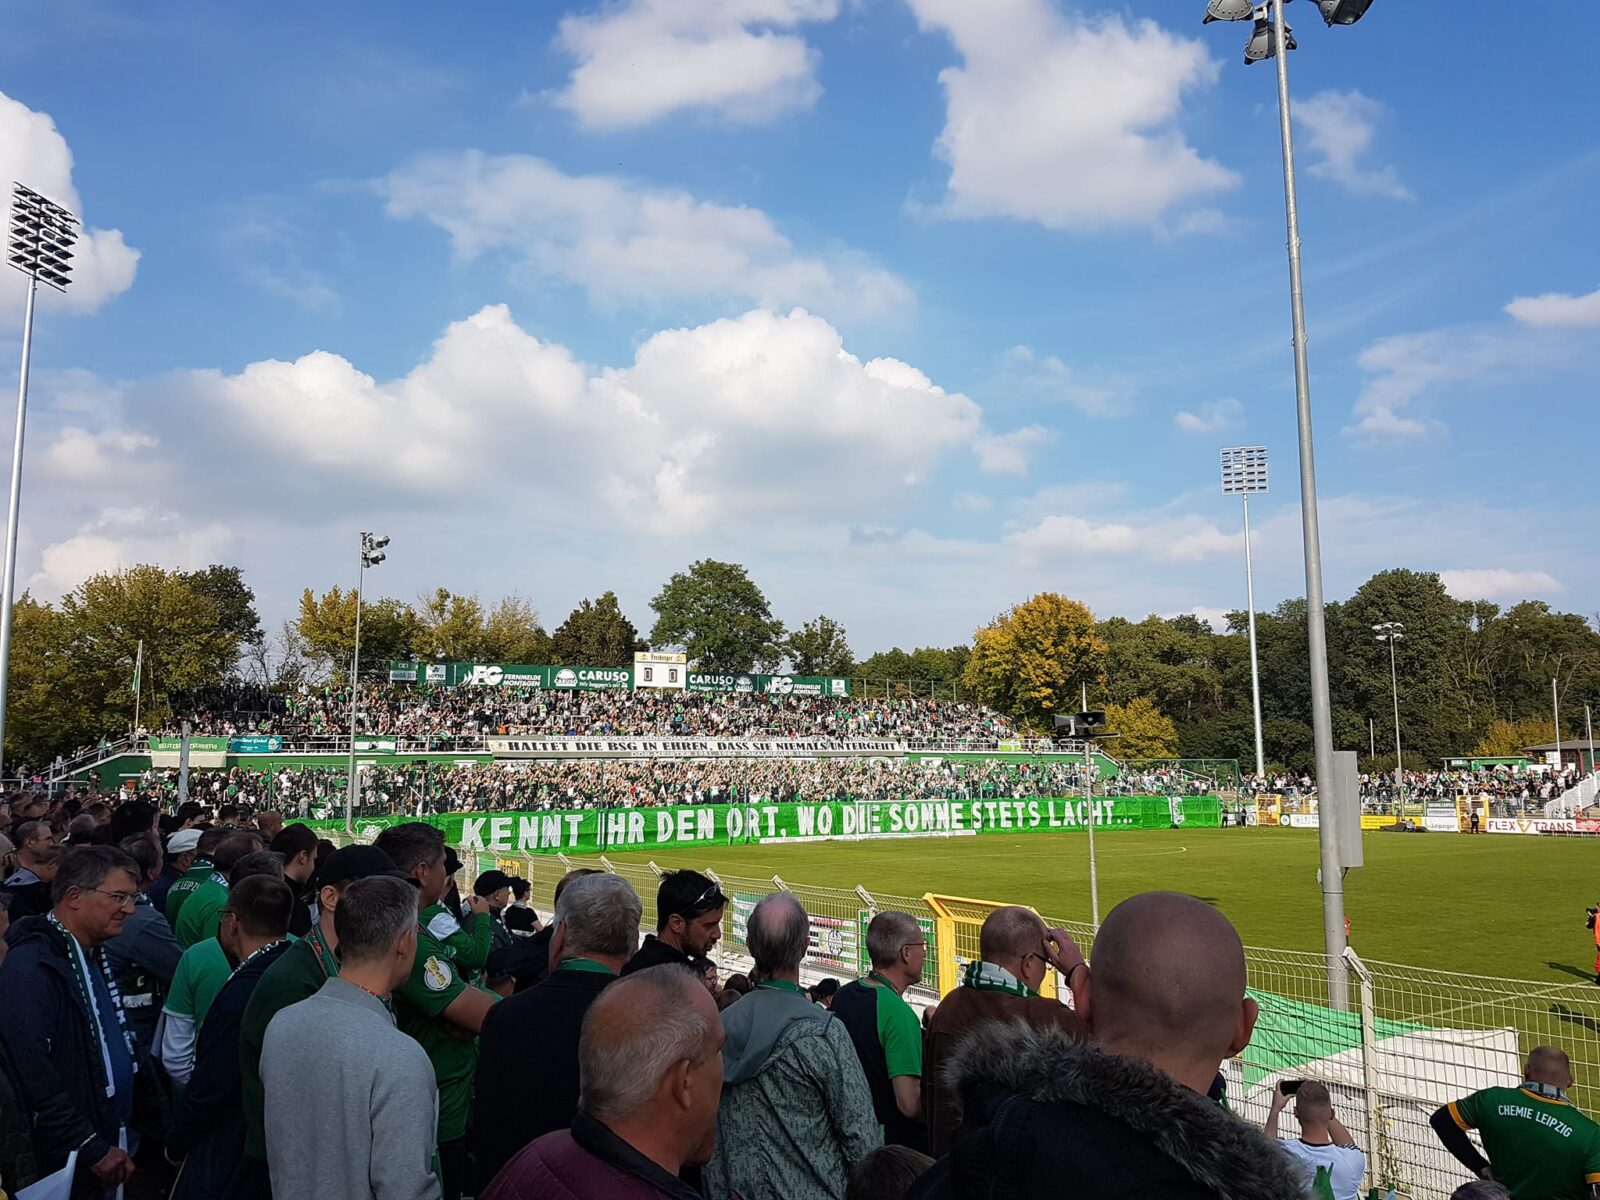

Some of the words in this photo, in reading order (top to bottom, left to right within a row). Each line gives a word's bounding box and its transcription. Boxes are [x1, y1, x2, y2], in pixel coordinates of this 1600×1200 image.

[578, 670, 629, 681] CARUSO
[689, 674, 734, 685] CARUSO
[507, 741, 569, 751] HALTET
[575, 741, 603, 751] DIE
[608, 741, 638, 751] BSG
[642, 741, 658, 751] IN
[717, 742, 749, 751] DASS
[752, 742, 772, 751] SIE
[775, 742, 827, 751] NIEMALS
[830, 742, 896, 751] UNTERGEHT
[461, 813, 584, 854] KENNT
[597, 810, 644, 845] IHR
[656, 808, 715, 841] DEN
[796, 805, 832, 834] WO
[842, 804, 881, 834] DIE
[888, 802, 964, 832] SONNE
[971, 800, 1041, 829] STETS
[1488, 820, 1516, 831] FLEX
[1533, 821, 1574, 831] TRANS
[180, 880, 200, 892] LEIPZI
[1498, 1104, 1535, 1120] CHEMIE
[1535, 1111, 1573, 1138] LEIPZIG
